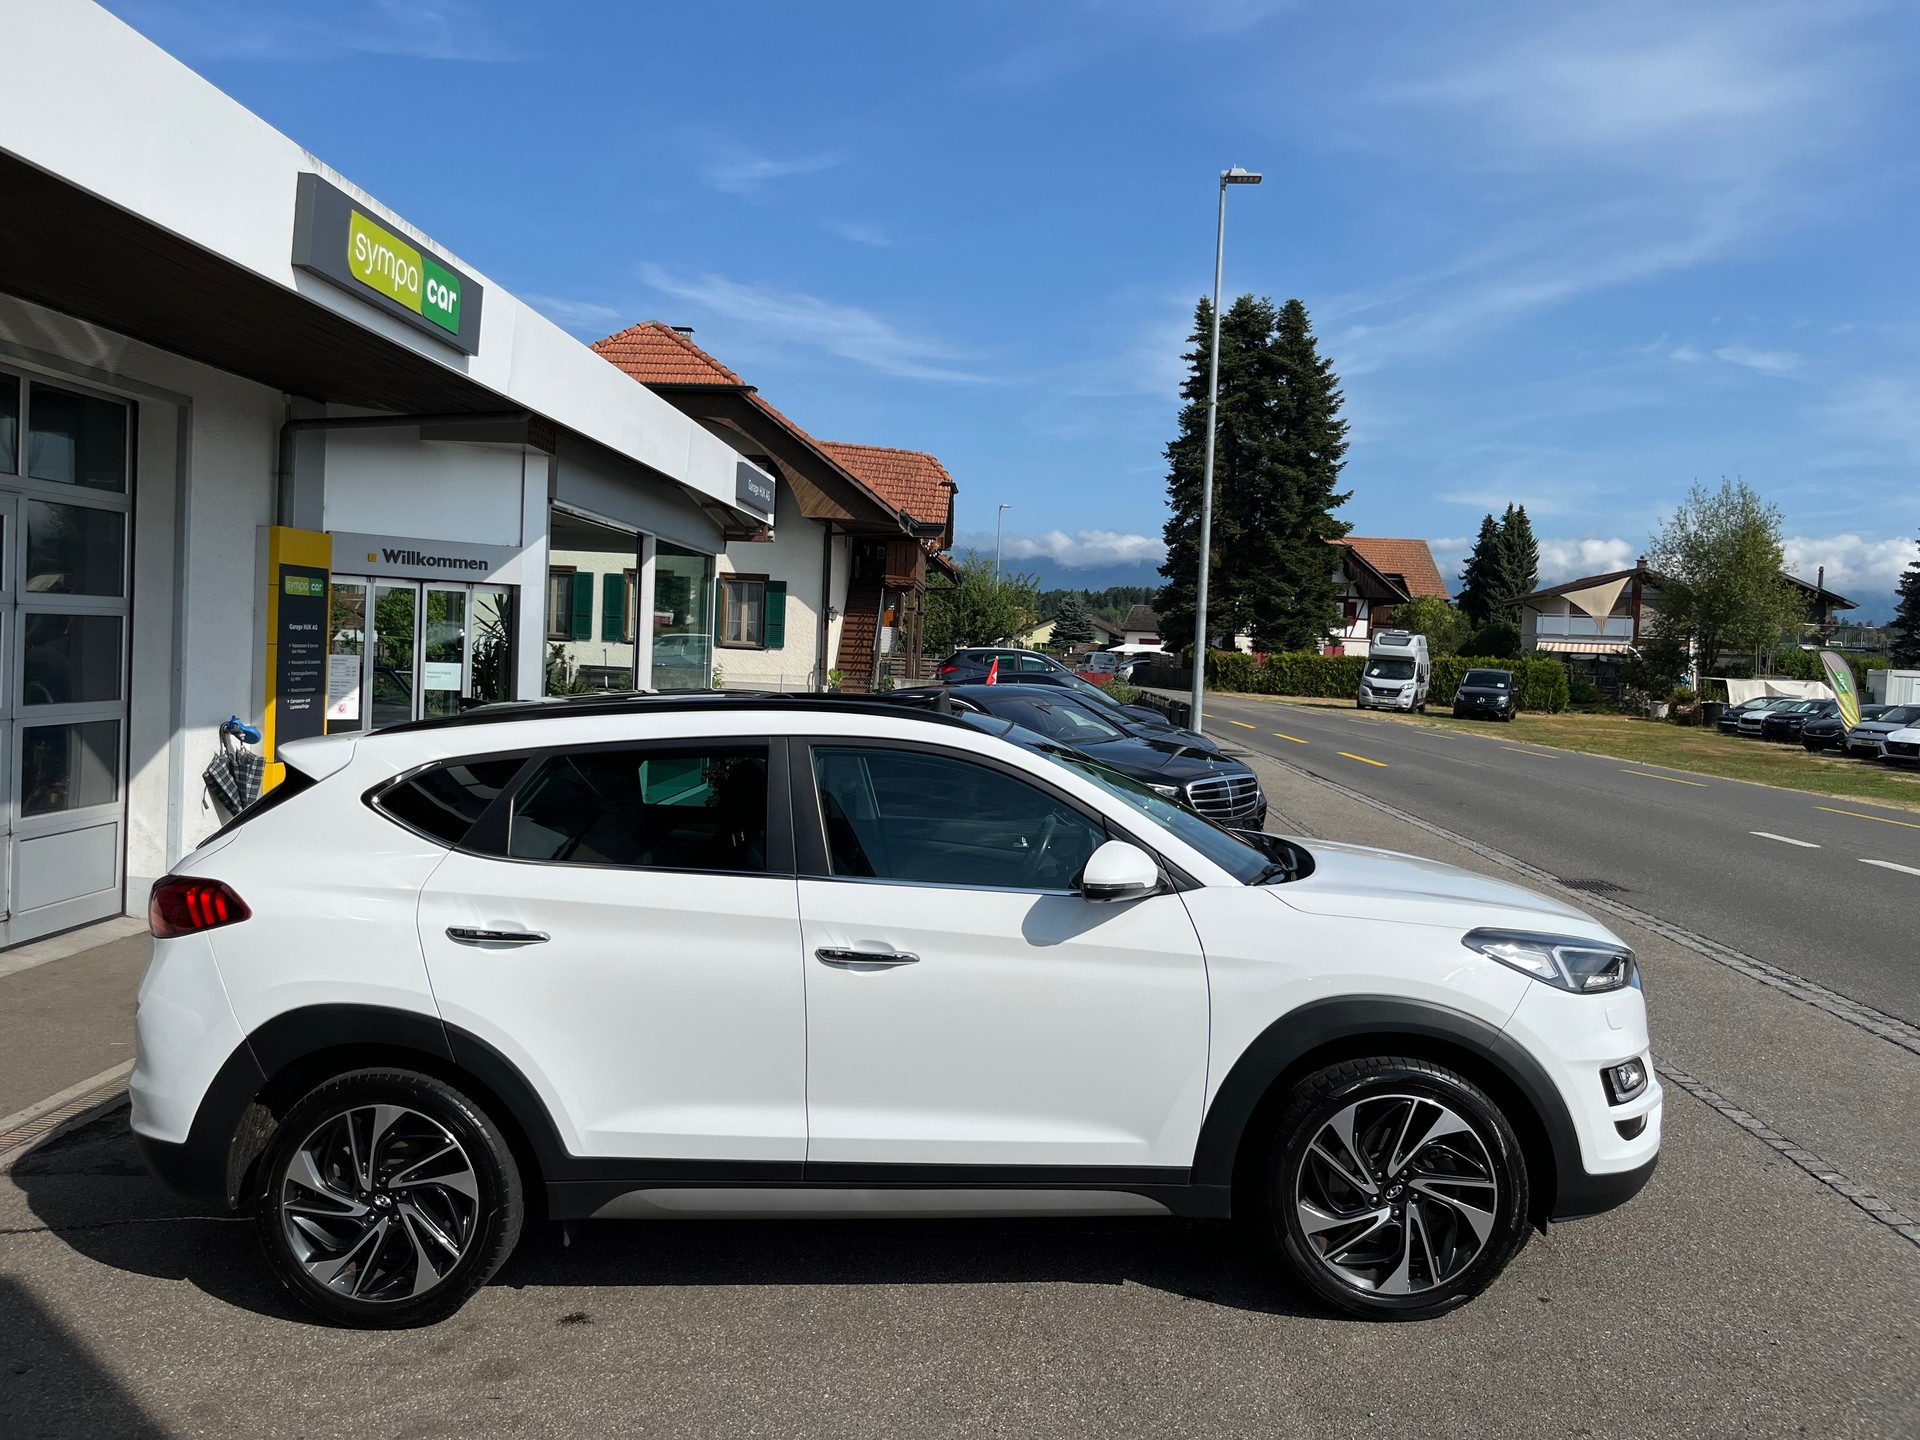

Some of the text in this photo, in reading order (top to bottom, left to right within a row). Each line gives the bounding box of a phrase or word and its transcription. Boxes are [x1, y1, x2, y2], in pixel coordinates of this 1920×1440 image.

[355, 232, 457, 314] sympa car
[382, 548, 489, 571] Willkommen
[287, 580, 323, 593] sympa car
[289, 623, 304, 632] Garage
